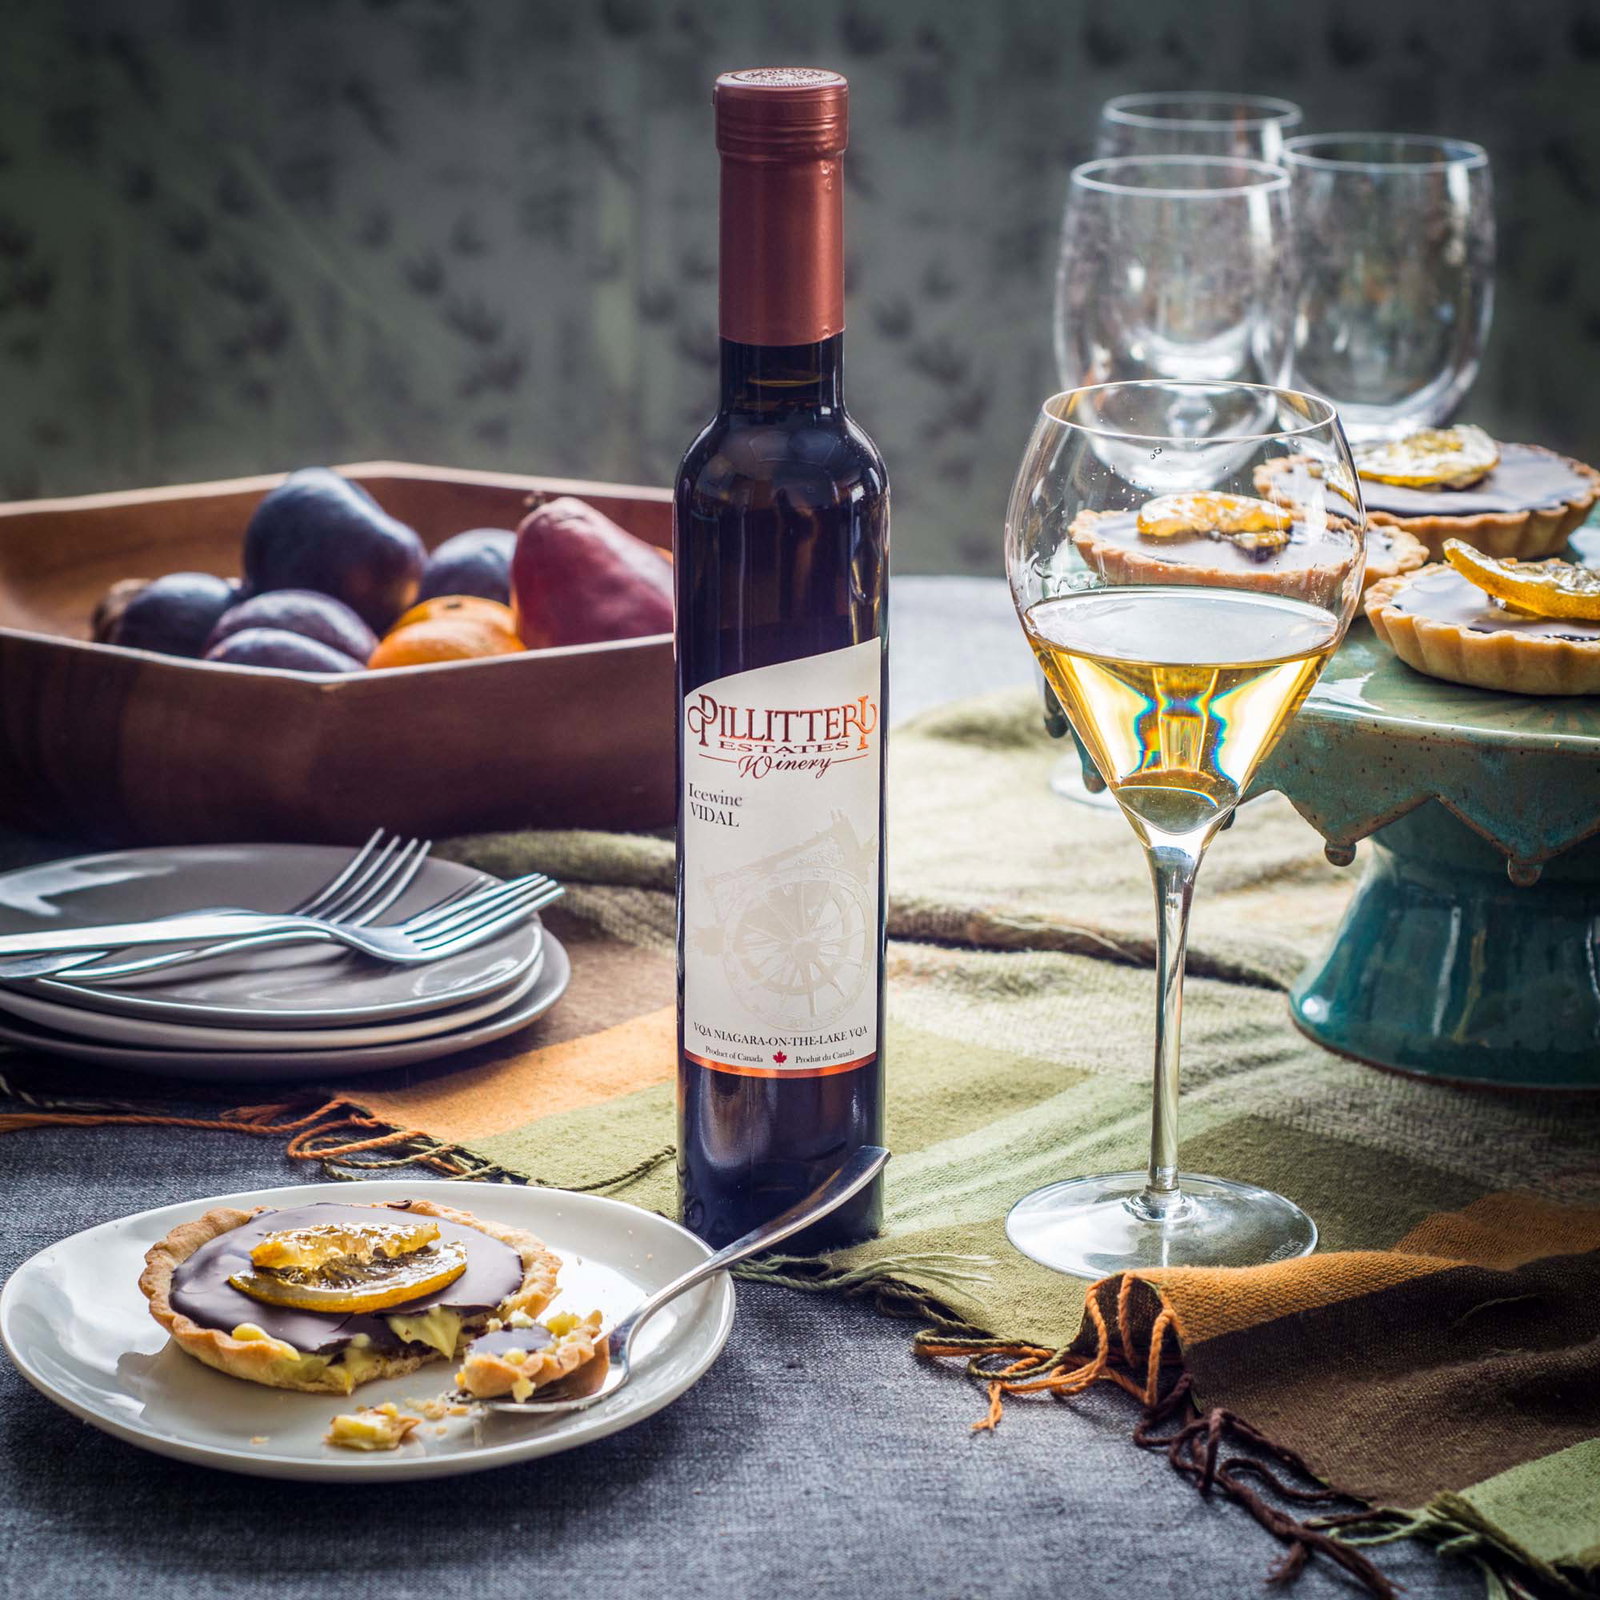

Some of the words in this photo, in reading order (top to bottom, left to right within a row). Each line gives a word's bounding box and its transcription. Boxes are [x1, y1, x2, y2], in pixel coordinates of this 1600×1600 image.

[687, 693, 877, 751] PILLITTERI
[719, 740, 849, 754] ESTATES
[737, 754, 832, 780] Winery
[689, 782, 743, 807] Icewine
[691, 801, 740, 828] VIDAL
[693, 1021, 712, 1037] VQA
[714, 1028, 848, 1047] NIAGARA-ON-THE-LAKE
[849, 1025, 868, 1037] VQA
[705, 1045, 728, 1059] Product
[729, 1052, 736, 1060] of
[737, 1052, 764, 1063] Canada
[795, 1055, 821, 1064] Produit
[822, 1053, 831, 1062] du
[832, 1048, 855, 1060] Canada
